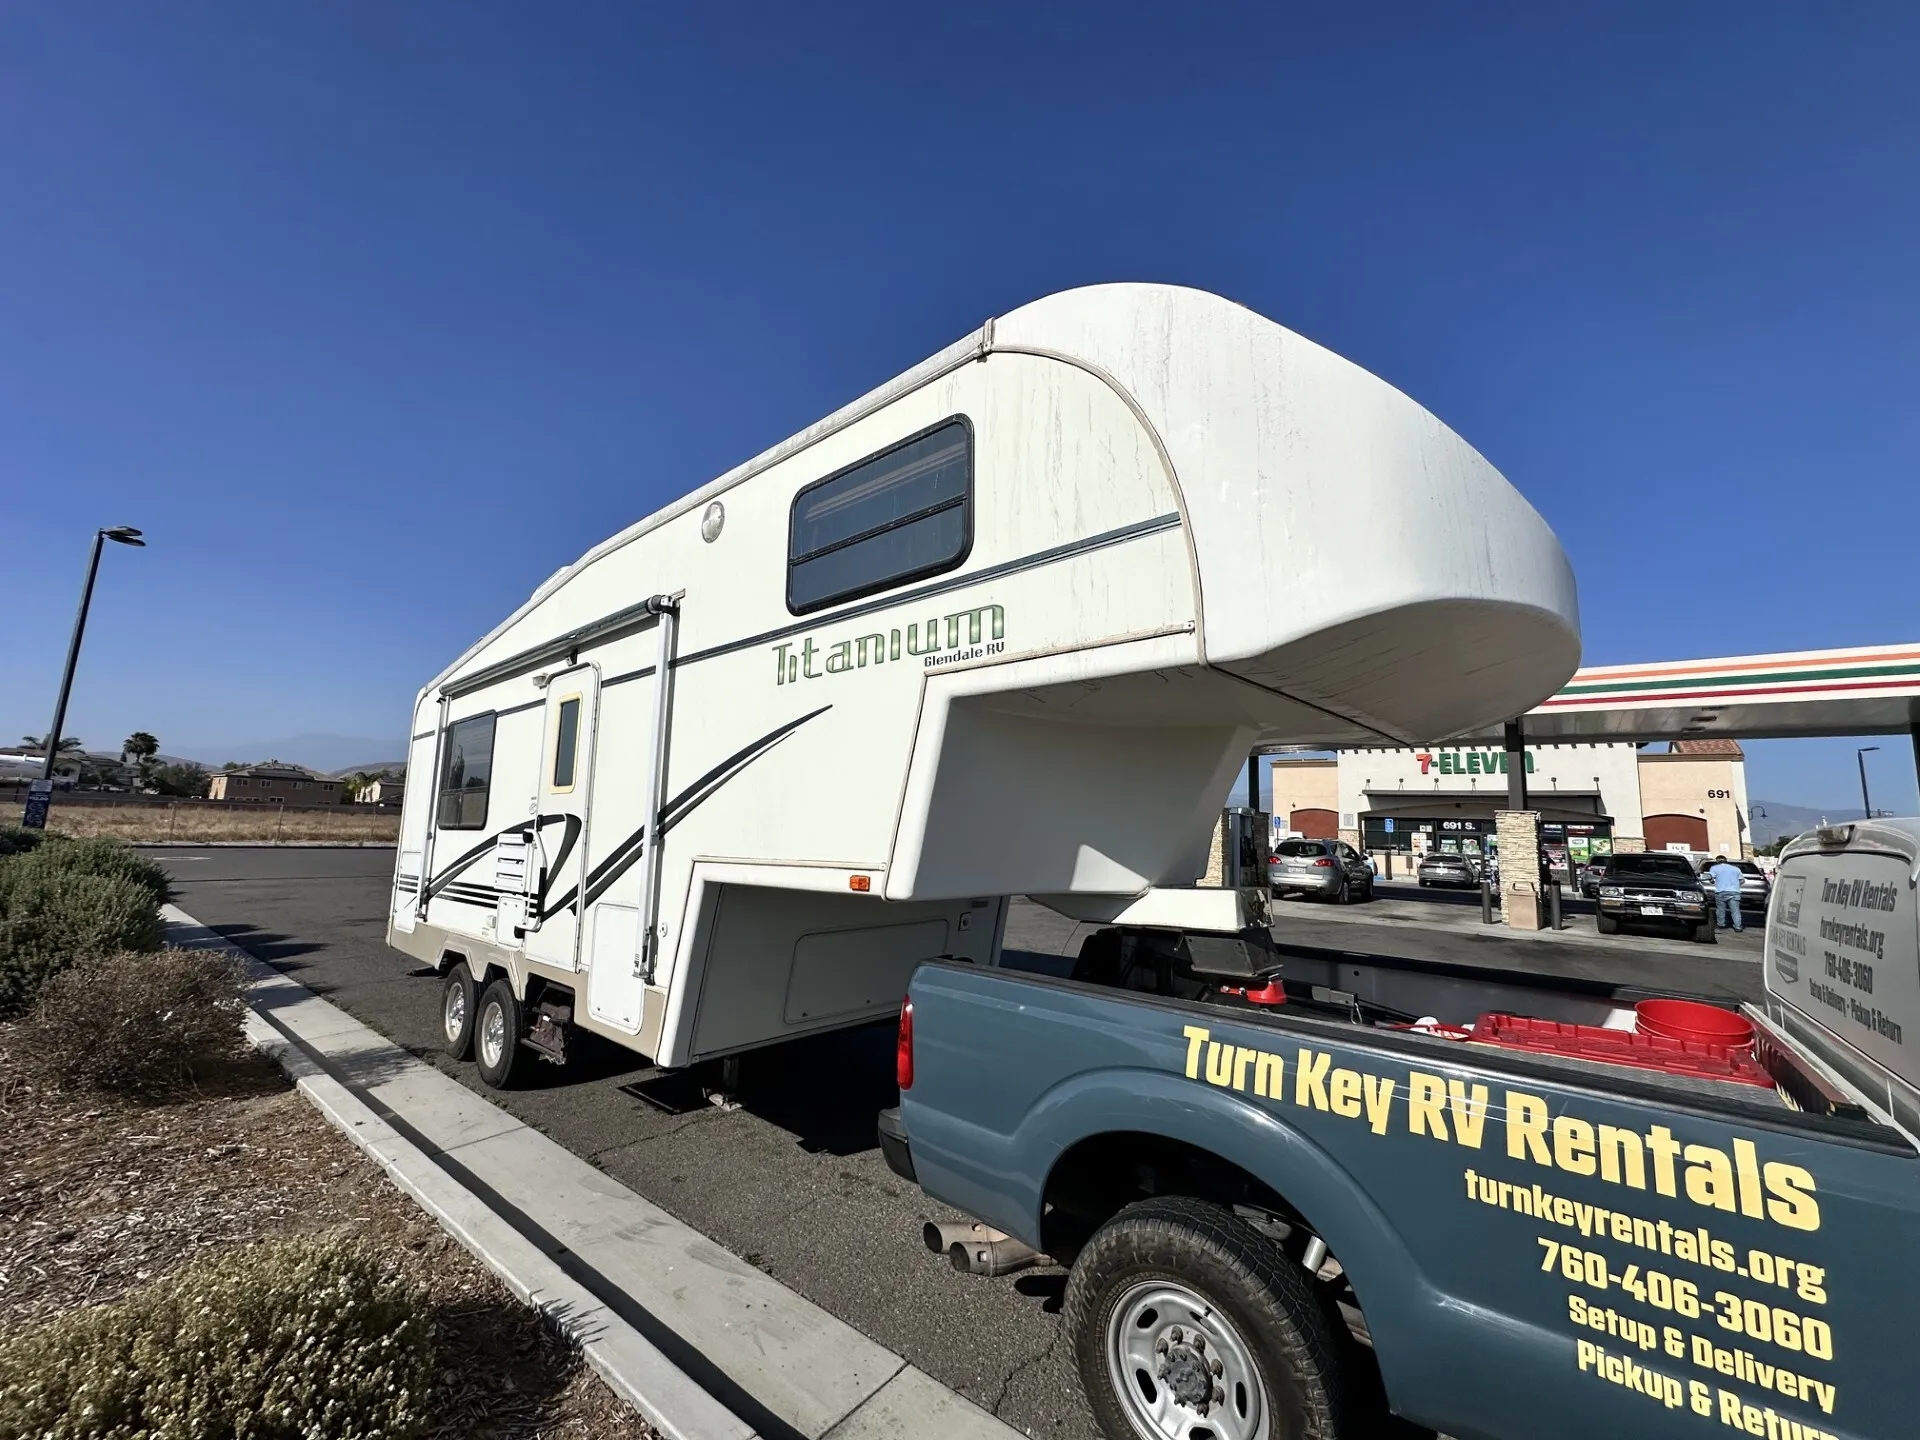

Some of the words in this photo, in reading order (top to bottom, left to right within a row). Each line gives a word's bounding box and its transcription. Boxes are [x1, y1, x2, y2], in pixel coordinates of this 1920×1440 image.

[772, 604, 1005, 686] Titanium
[924, 647, 983, 667] Glendale
[986, 641, 1005, 656] RV
[1707, 789, 1731, 799] 691
[1442, 821, 1462, 830] 691
[1464, 821, 1476, 830] S.
[1821, 877, 1838, 904] Turn
[1835, 878, 1852, 910] Key
[1849, 879, 1864, 907] RV
[1861, 880, 1898, 912] Rentals
[1820, 915, 1885, 960] turnkeyrentals.org
[1824, 950, 1873, 994] 760-406-3060
[1877, 1009, 1902, 1045] Return
[1183, 1025, 1284, 1100] Turn
[1295, 1049, 1395, 1136] Key
[1408, 1071, 1489, 1149] RV
[1506, 1091, 1821, 1232] Rentals
[1465, 1169, 1828, 1304] turnkeyrentals.org
[1538, 1237, 1833, 1361] 760-406-3060
[1568, 1294, 1657, 1350] Setup
[1663, 1326, 1686, 1358] &
[1691, 1334, 1836, 1414] Delivery
[1577, 1338, 1683, 1409] Pickup
[1689, 1379, 1712, 1417] &
[1717, 1388, 1839, 1440] Retur
